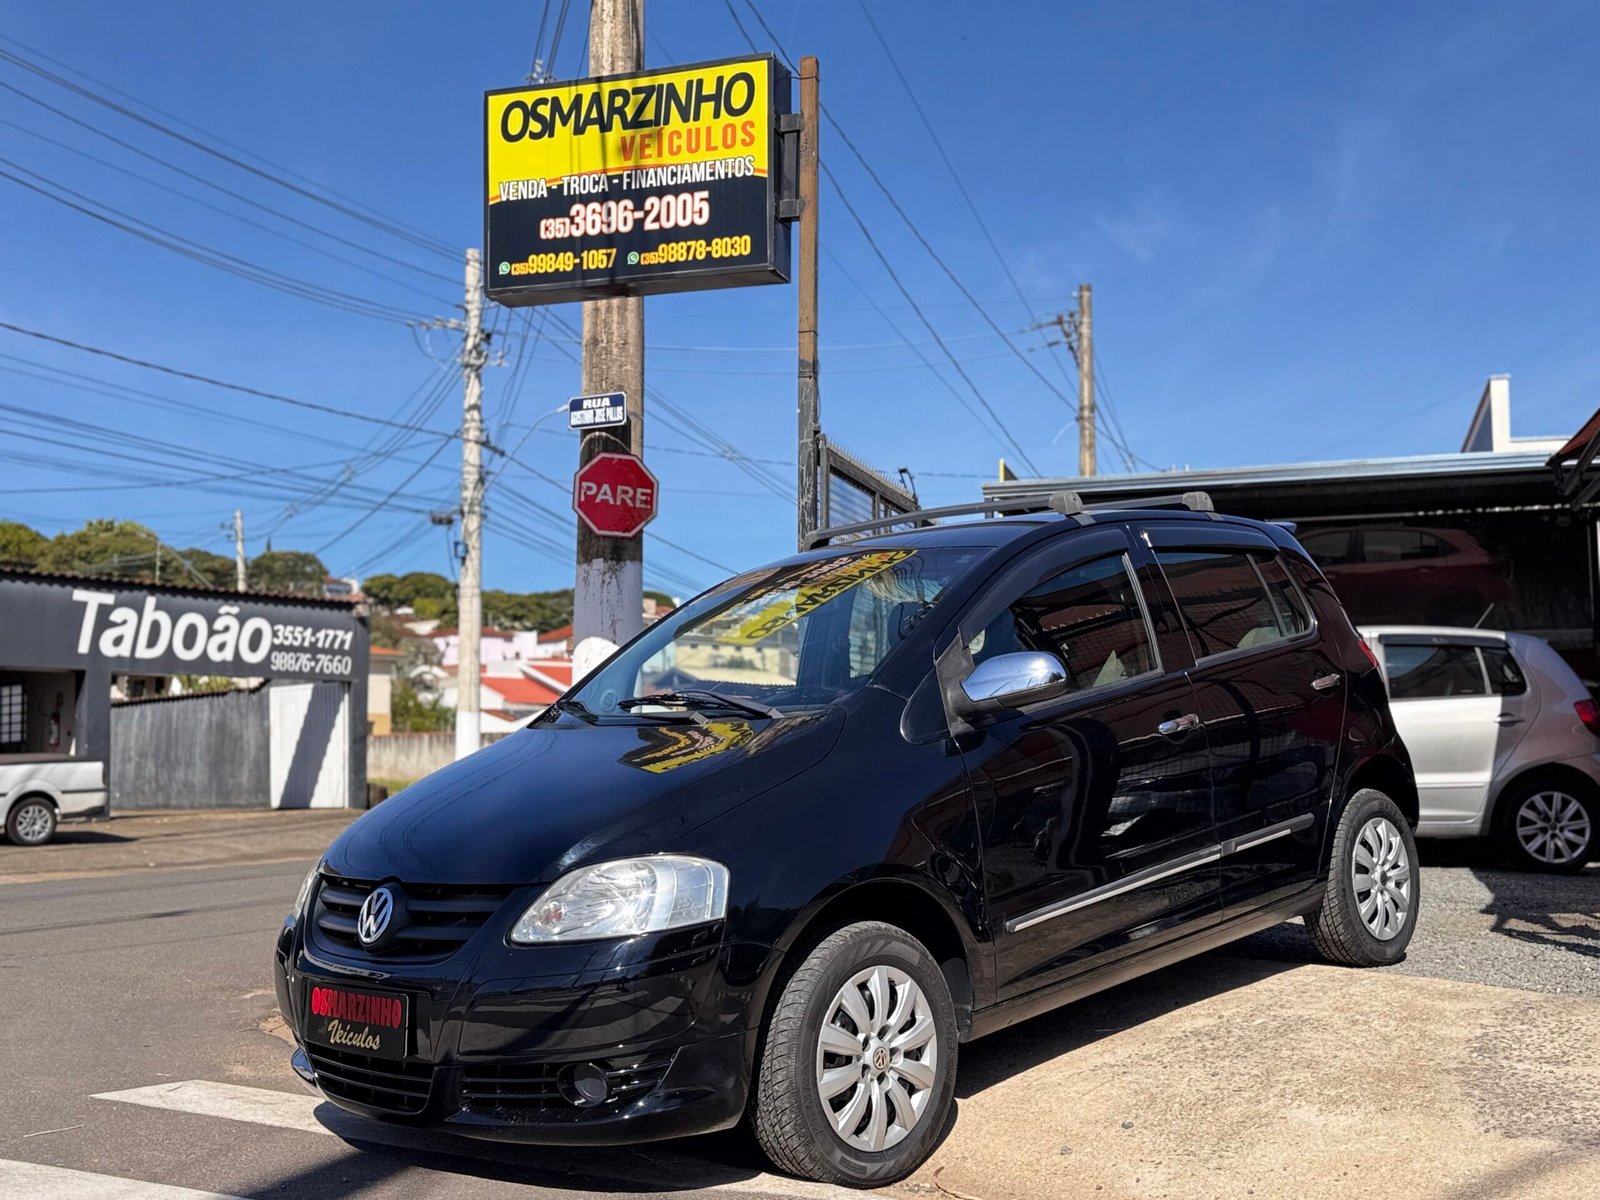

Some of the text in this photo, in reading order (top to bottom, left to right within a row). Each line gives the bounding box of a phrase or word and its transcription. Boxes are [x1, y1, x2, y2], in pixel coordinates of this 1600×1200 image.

[501, 72, 755, 143] OSMARZINHO
[620, 120, 755, 161] VEÍCULOS
[499, 178, 548, 201] VENDA
[562, 173, 609, 197] TROCA
[623, 155, 755, 191] FINANCIAMENTOS
[582, 397, 610, 410] RUA
[580, 481, 652, 509] PARE
[72, 589, 273, 663] Taboão
[311, 986, 402, 1029] OSMARZINHO
